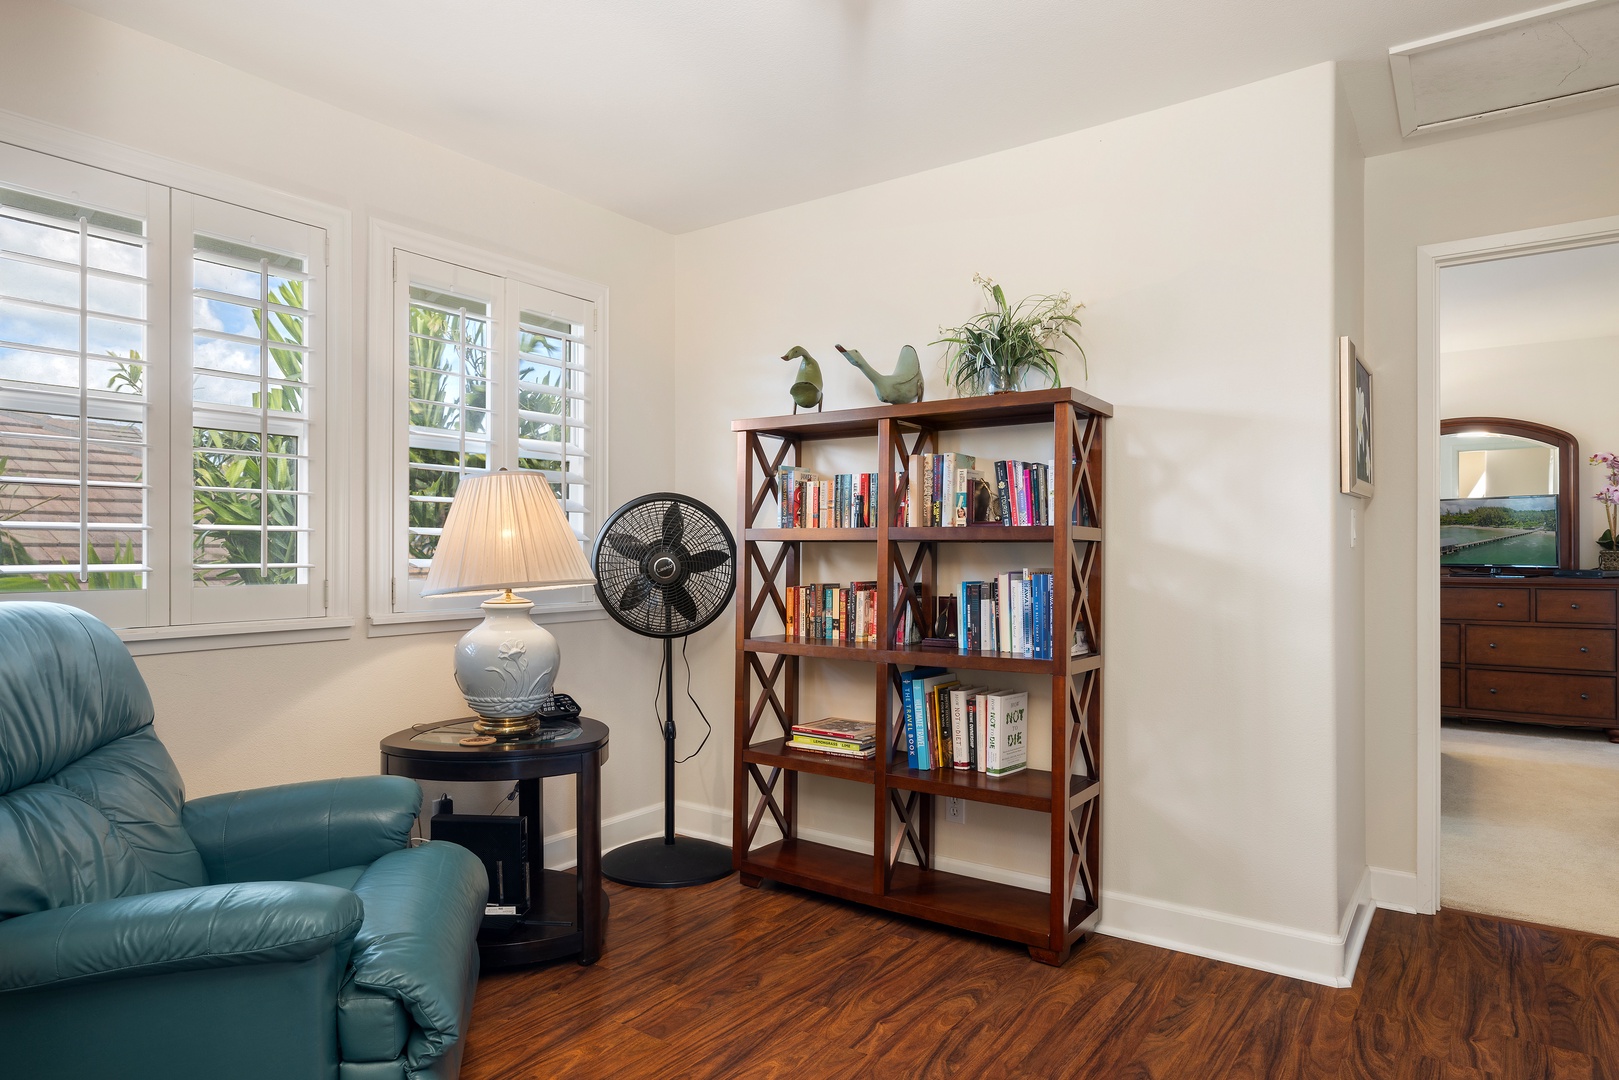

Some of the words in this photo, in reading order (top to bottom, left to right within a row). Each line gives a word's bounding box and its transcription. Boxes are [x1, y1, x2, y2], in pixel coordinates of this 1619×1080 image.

[914, 704, 923, 728] ULTIMATE
[1006, 708, 1024, 724] NOT
[1008, 732, 1022, 747] DIE
